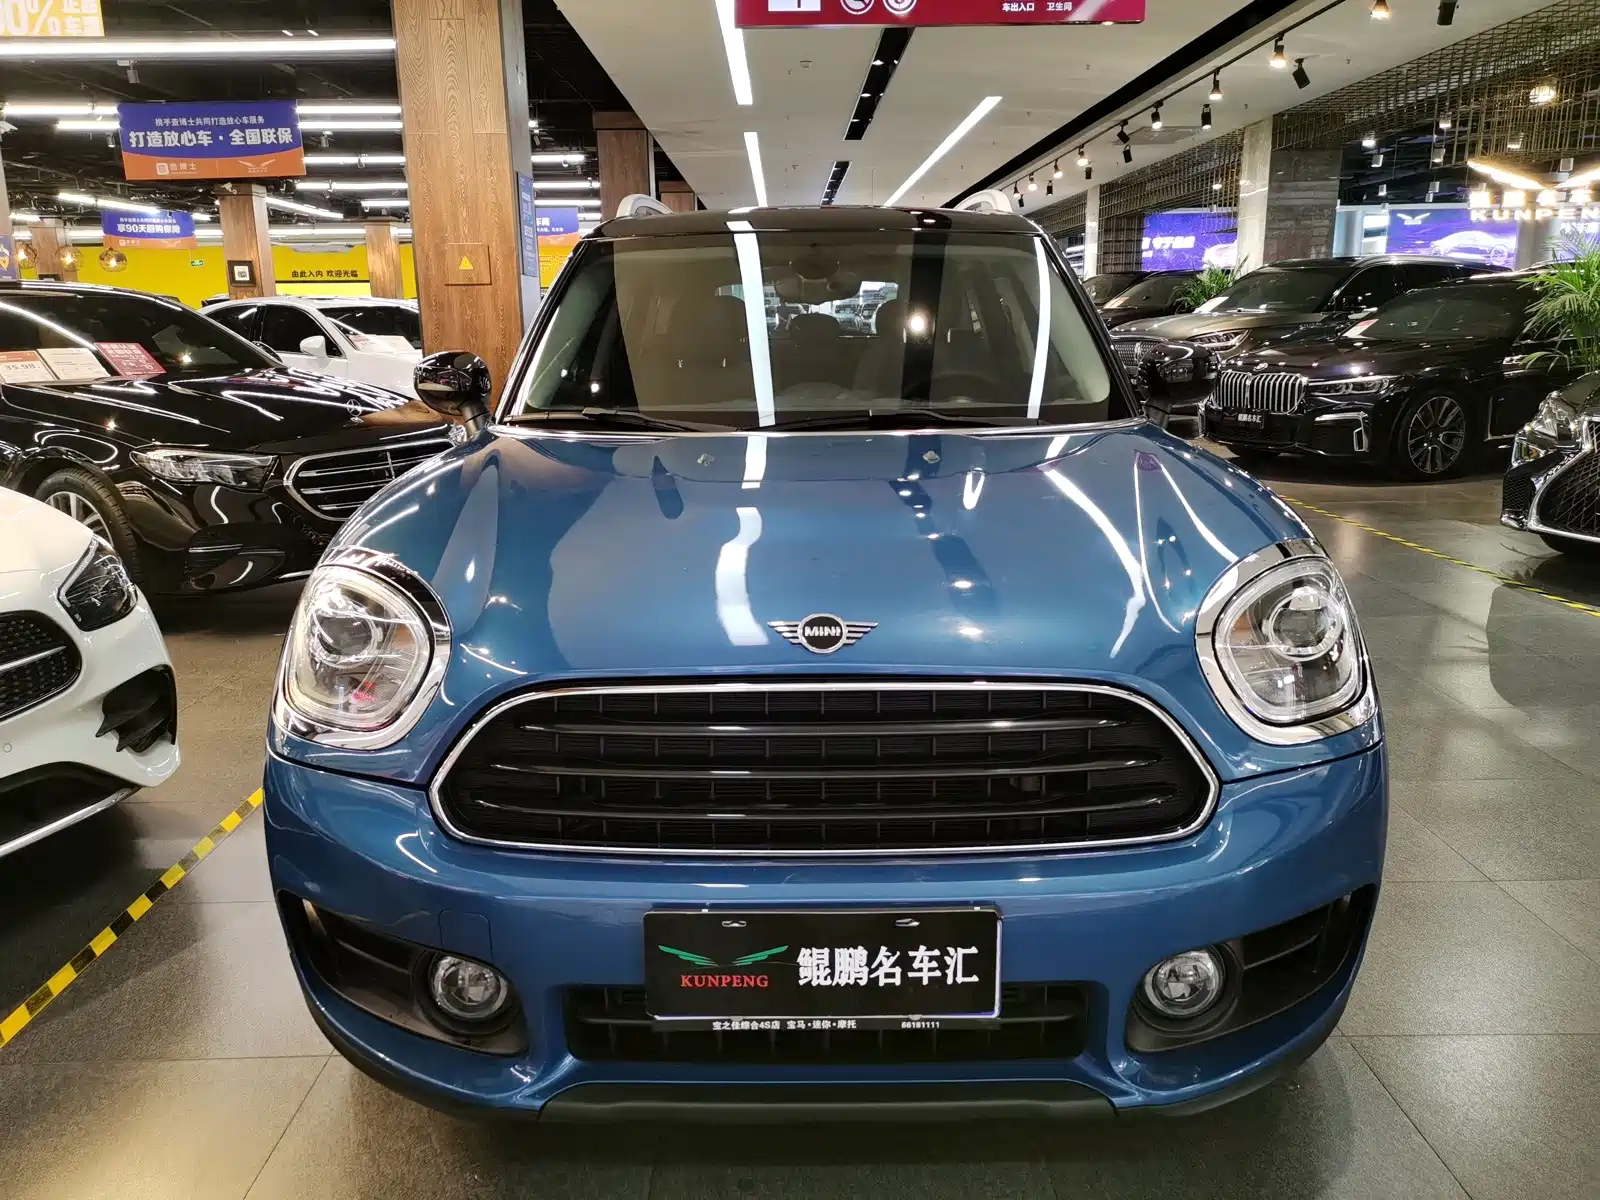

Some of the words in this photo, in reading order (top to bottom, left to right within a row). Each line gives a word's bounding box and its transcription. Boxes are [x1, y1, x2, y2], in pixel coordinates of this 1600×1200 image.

[1002, 3, 1035, 12] 车出入口
[1046, 2, 1073, 11] 卫生间
[291, 269, 323, 278] 由此入内
[326, 269, 359, 278] 欢迎光临
[804, 626, 841, 637] MINI
[797, 945, 979, 987] 鲲鹏名车汇
[680, 974, 769, 988] KUNPENG
[712, 1020, 780, 1030] 宝之佳综合4S店
